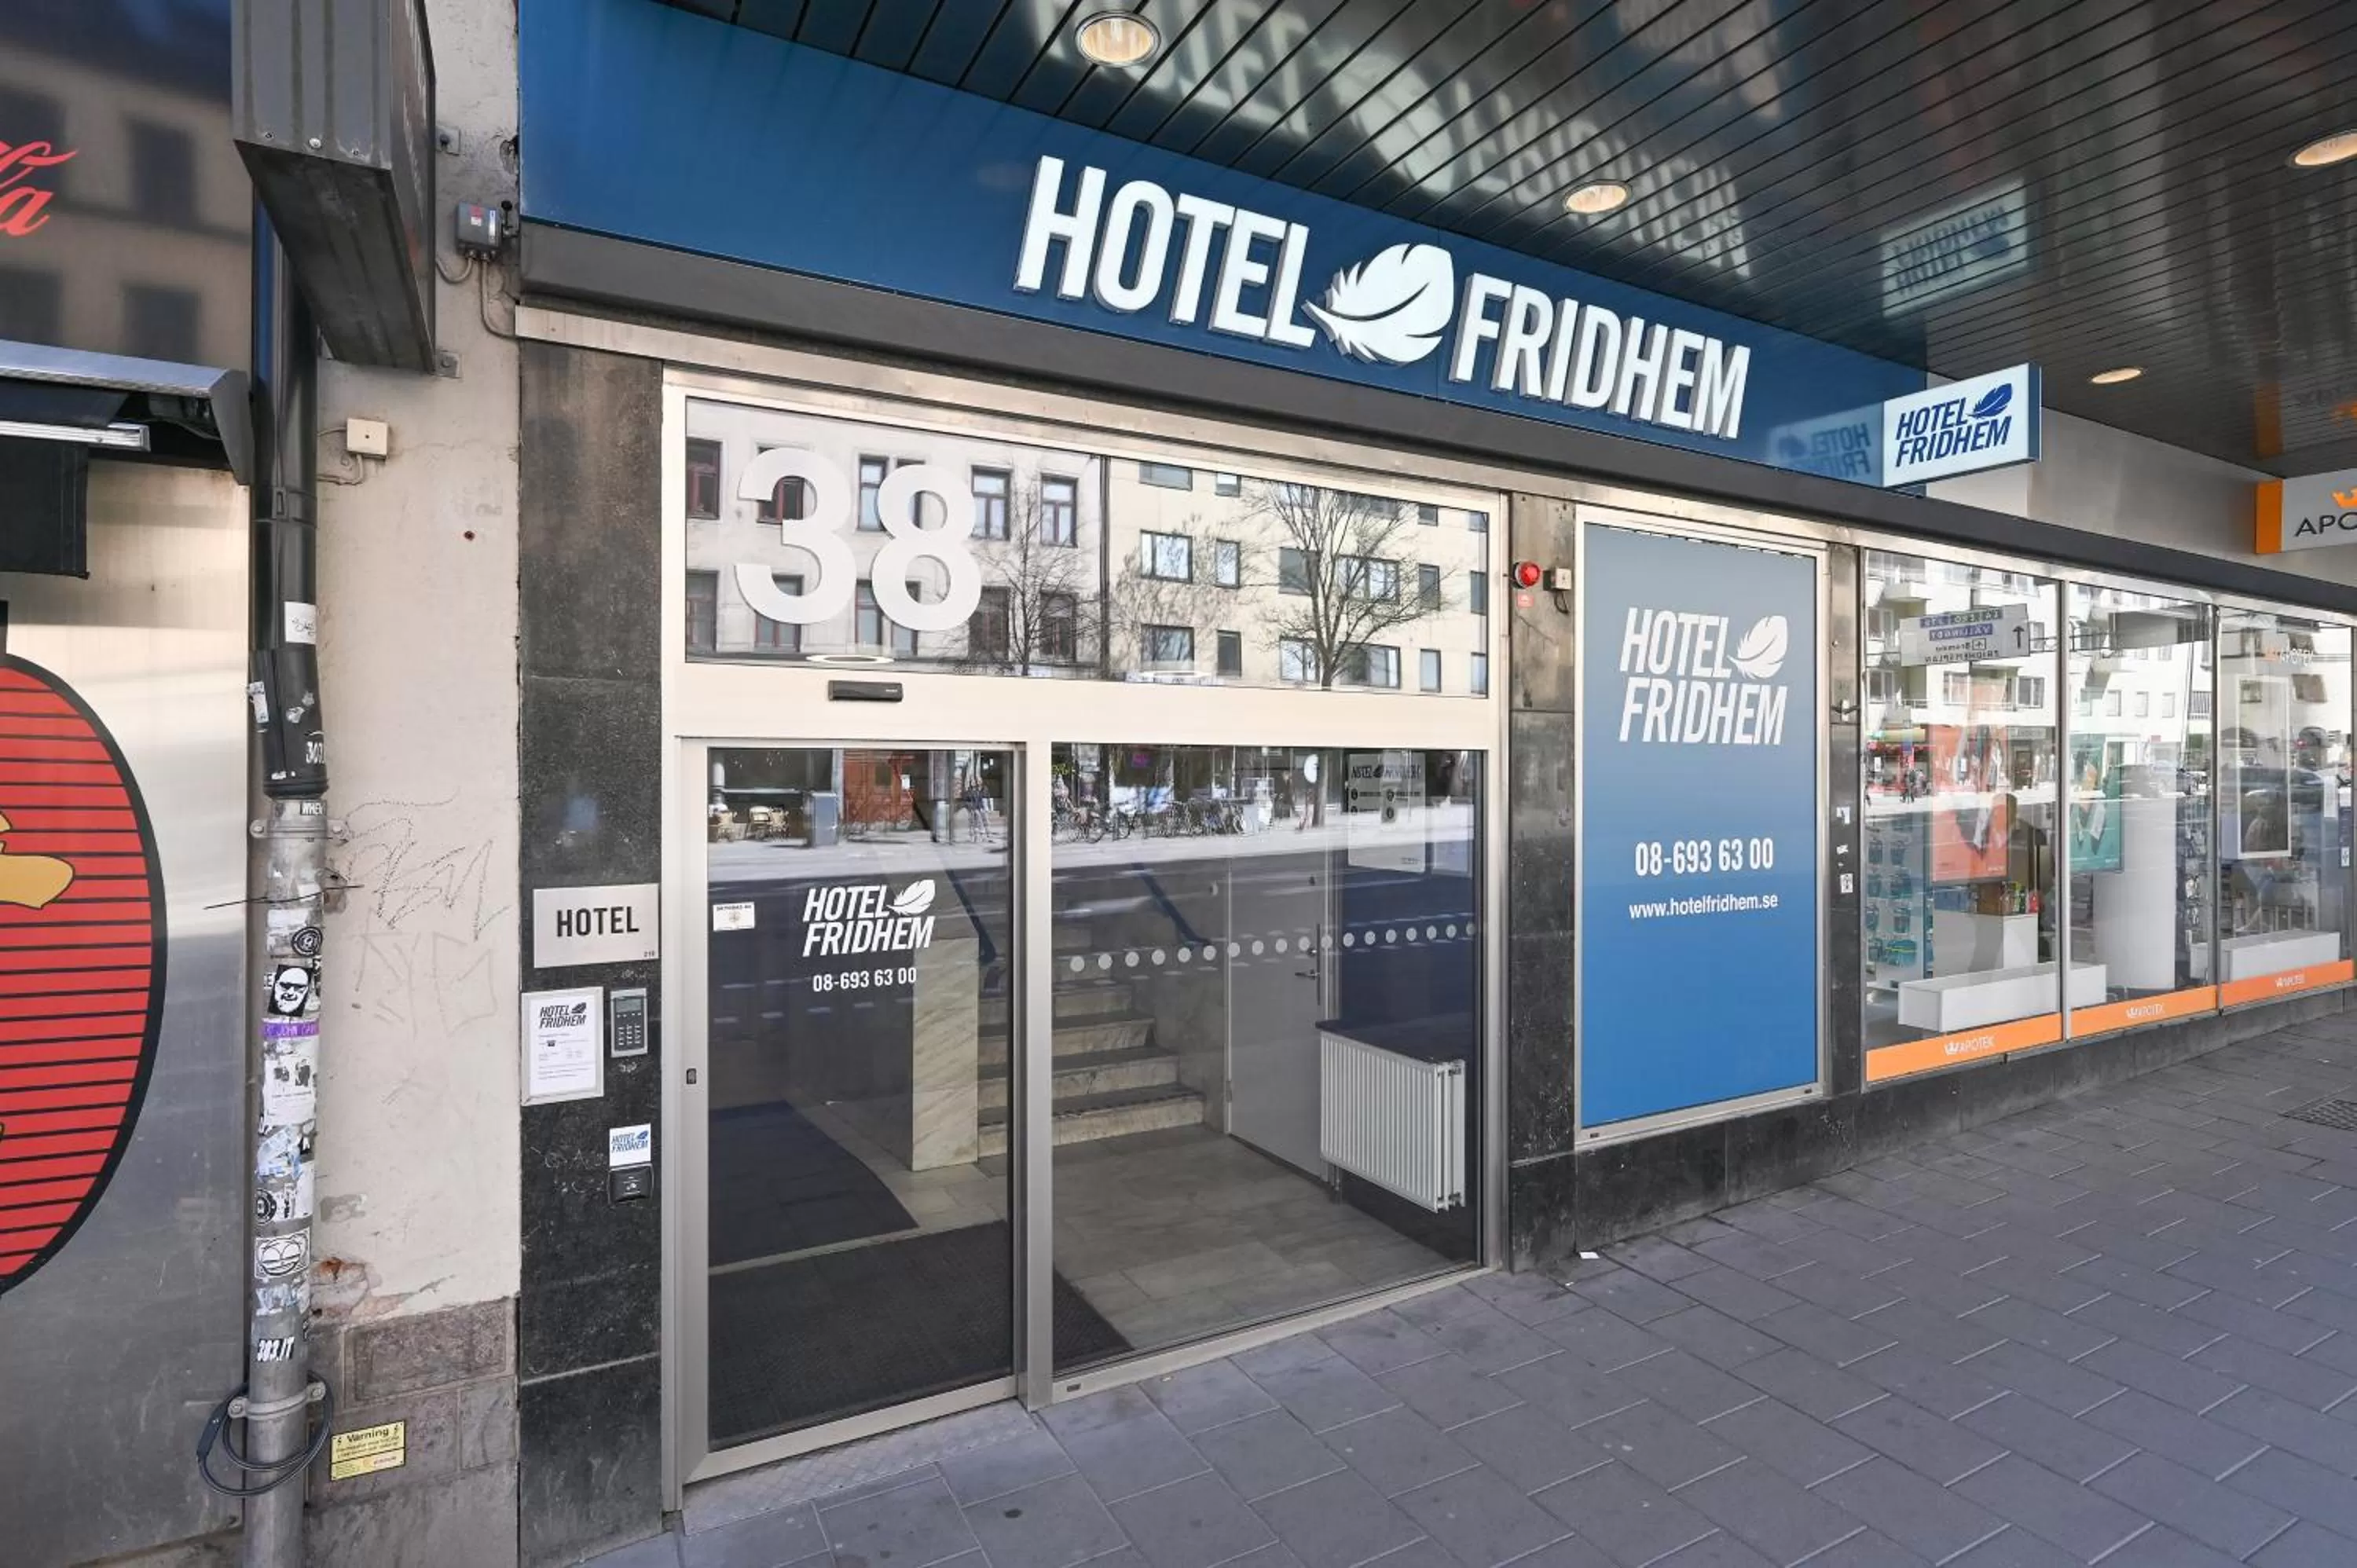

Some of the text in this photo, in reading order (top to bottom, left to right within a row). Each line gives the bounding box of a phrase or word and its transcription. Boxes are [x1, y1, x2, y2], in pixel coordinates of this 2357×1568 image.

[1014, 155, 1750, 439] HOTEL FRIDHEM
[1896, 397, 1968, 441] HOTEL
[1896, 416, 2012, 467] FRIDHEM
[735, 447, 982, 631] 38
[1620, 607, 1732, 679] HOTEL
[1619, 676, 1788, 746] FRIDHEM
[1635, 837, 1773, 876] 08-693 63 00
[556, 906, 640, 937] HOTEL
[802, 885, 890, 922] HOTEL
[1629, 894, 1780, 918] www.hotelfridhem.se
[802, 915, 936, 958] FRIDHEM
[812, 967, 917, 992] 08-693 63 00
[538, 1014, 587, 1029] FRIDHEM
[539, 1005, 570, 1017] HOTEL
